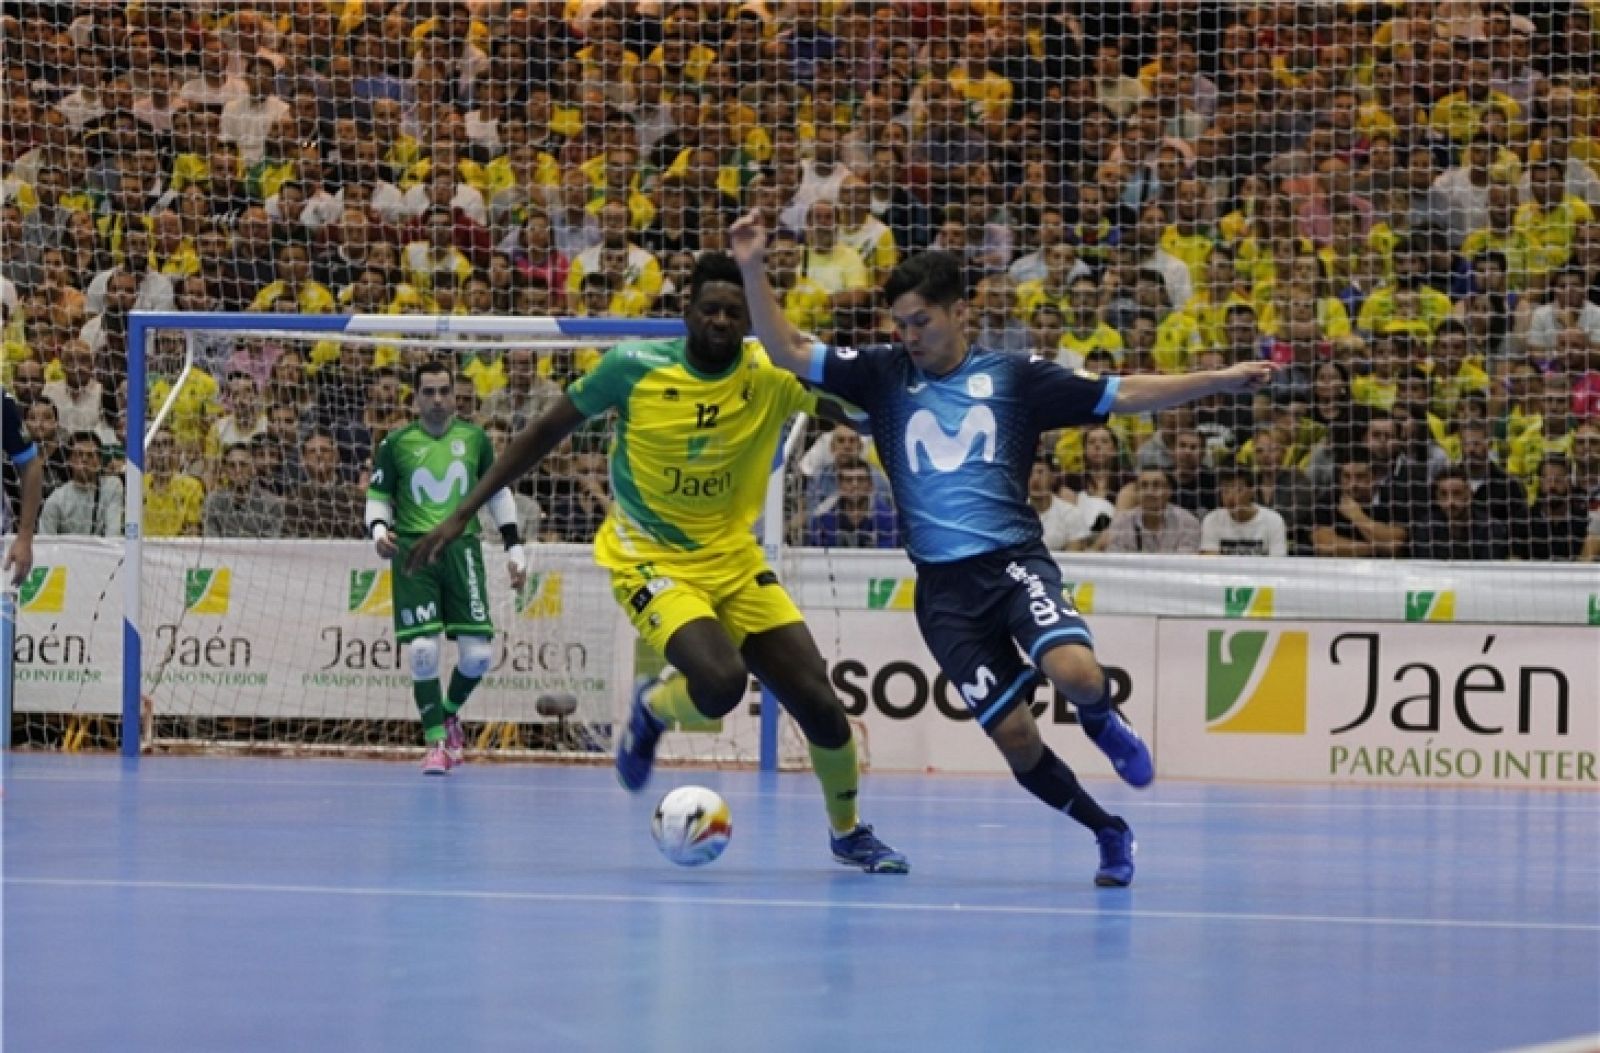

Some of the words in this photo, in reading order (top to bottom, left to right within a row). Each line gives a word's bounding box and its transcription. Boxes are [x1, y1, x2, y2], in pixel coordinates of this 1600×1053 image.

[695, 402, 720, 429] 12
[13, 622, 84, 665] aén
[155, 624, 251, 668] Jaén
[1329, 632, 1571, 736] Jaén
[1329, 738, 1483, 779] PARAÍSO
[1494, 749, 1598, 781] INTER
